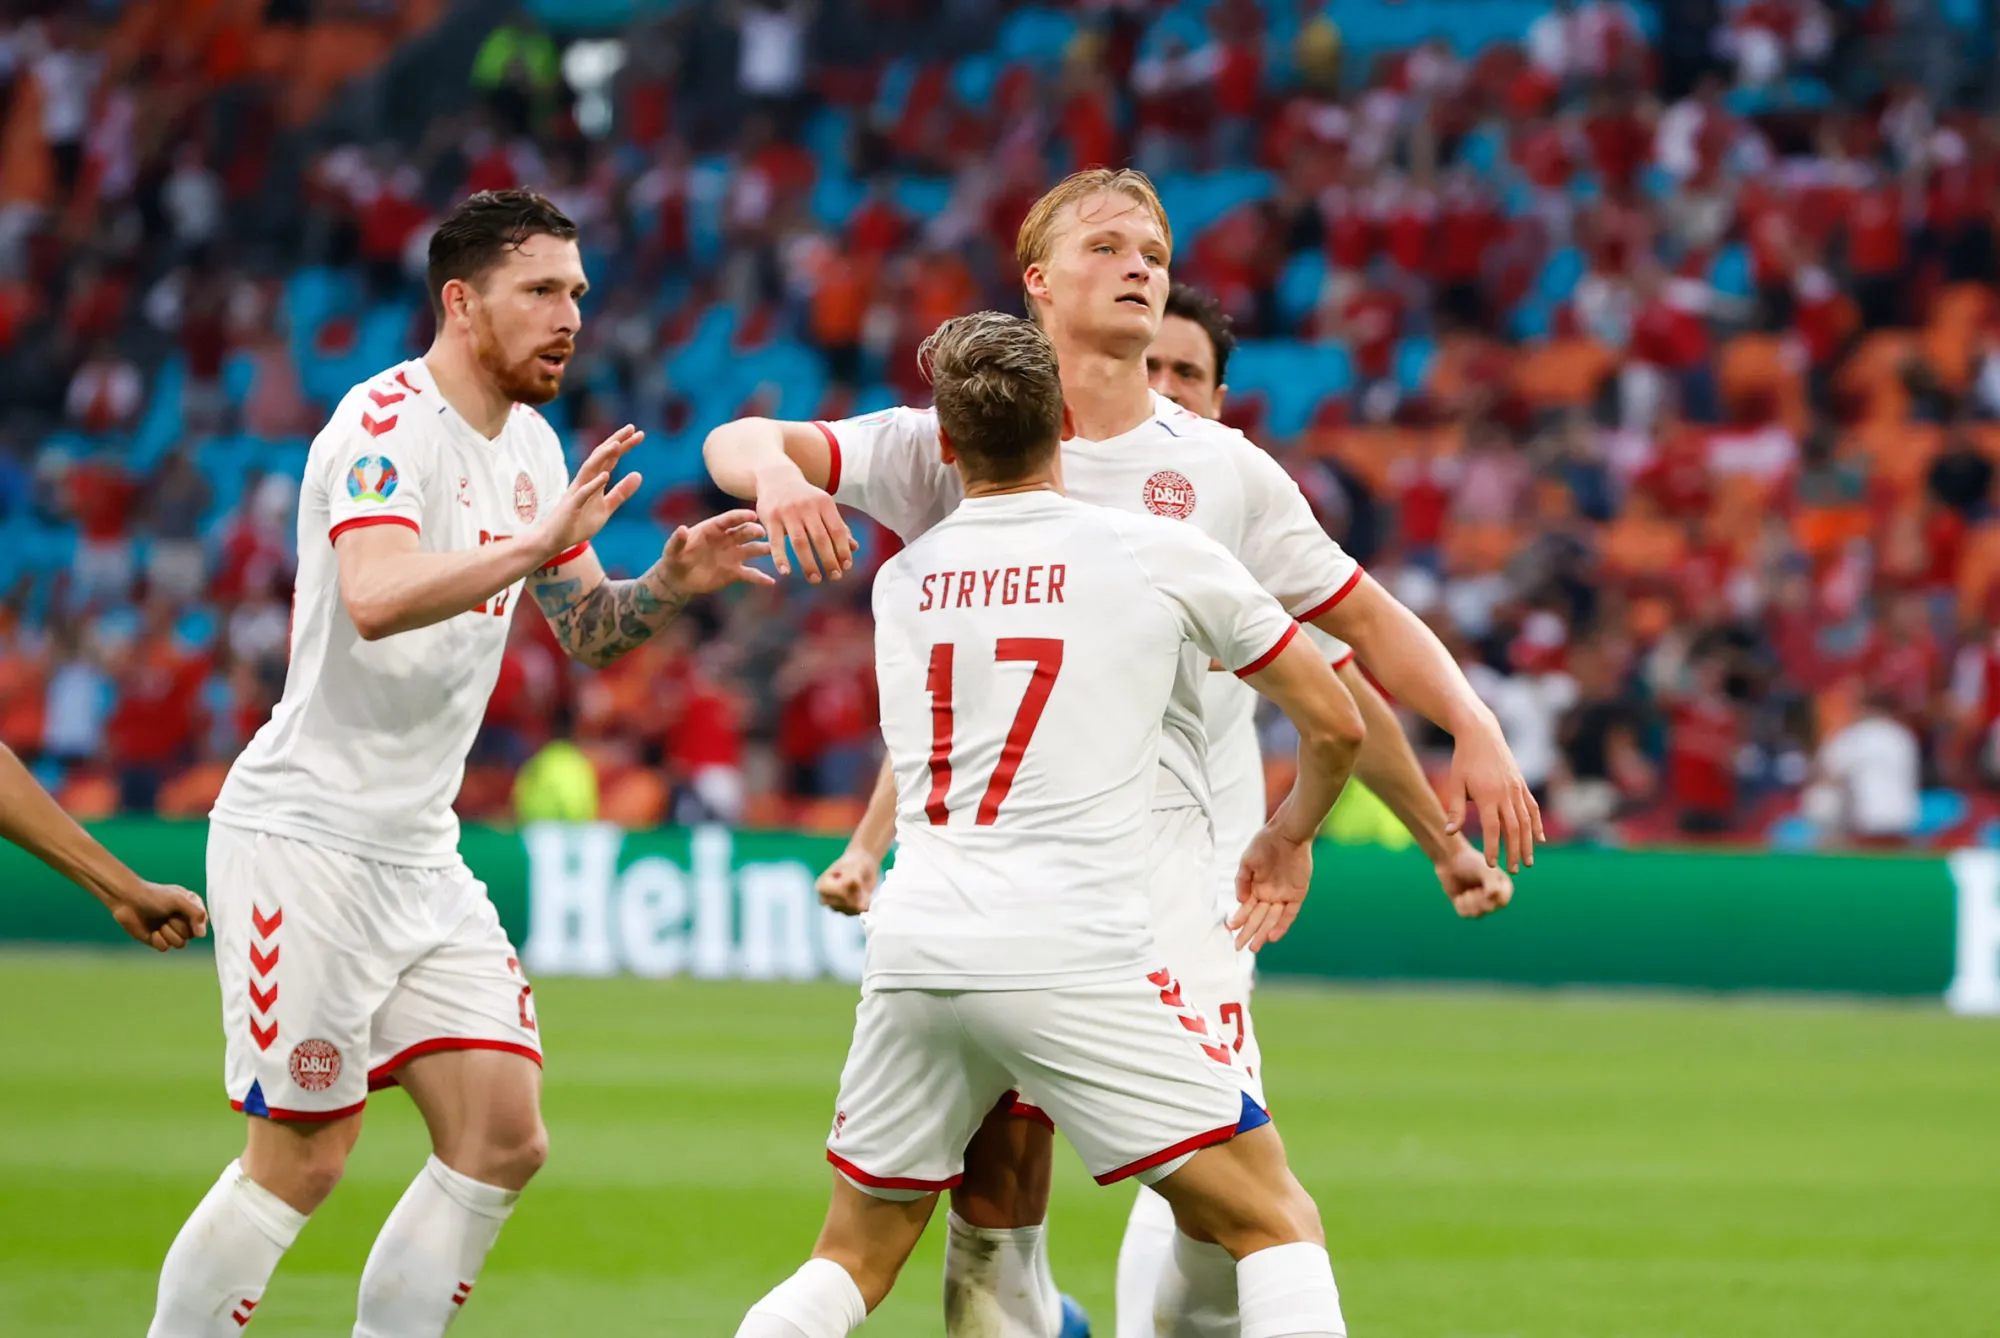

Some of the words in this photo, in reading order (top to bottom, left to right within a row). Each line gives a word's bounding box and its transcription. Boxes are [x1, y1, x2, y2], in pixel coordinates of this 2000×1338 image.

[1152, 486, 1187, 505] DBU
[919, 563, 1067, 613] STRYGER
[924, 636, 1065, 826] 17
[300, 1055, 331, 1073] DBU
